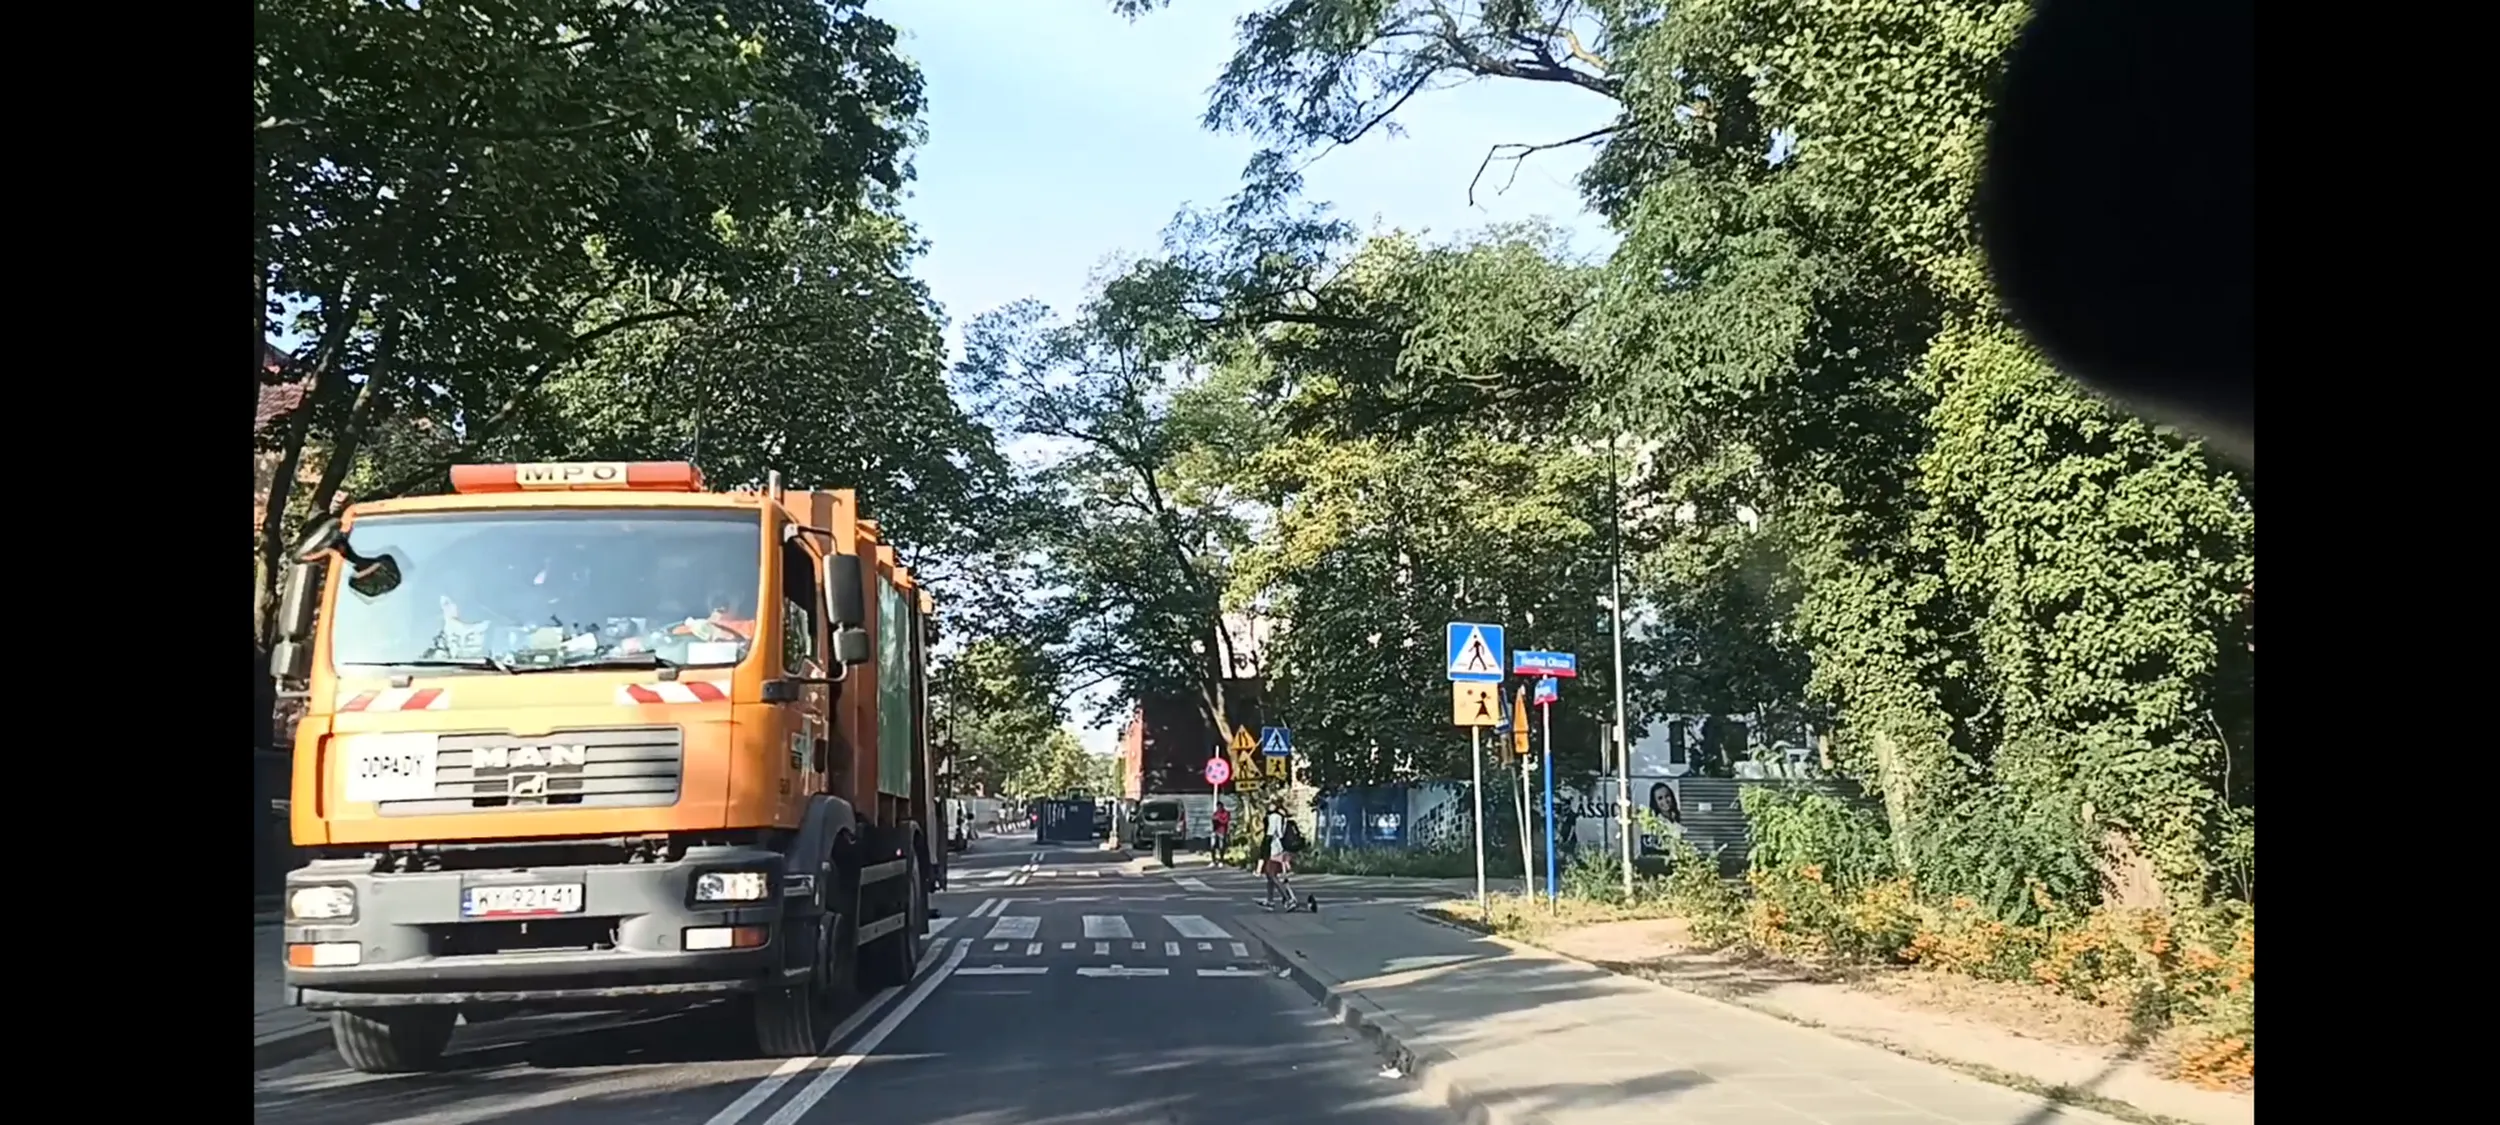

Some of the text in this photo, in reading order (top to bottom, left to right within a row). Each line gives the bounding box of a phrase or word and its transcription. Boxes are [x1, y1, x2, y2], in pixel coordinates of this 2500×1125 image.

[524, 466, 617, 481] MPO
[471, 745, 585, 769] MAN
[512, 887, 574, 907] 92141
